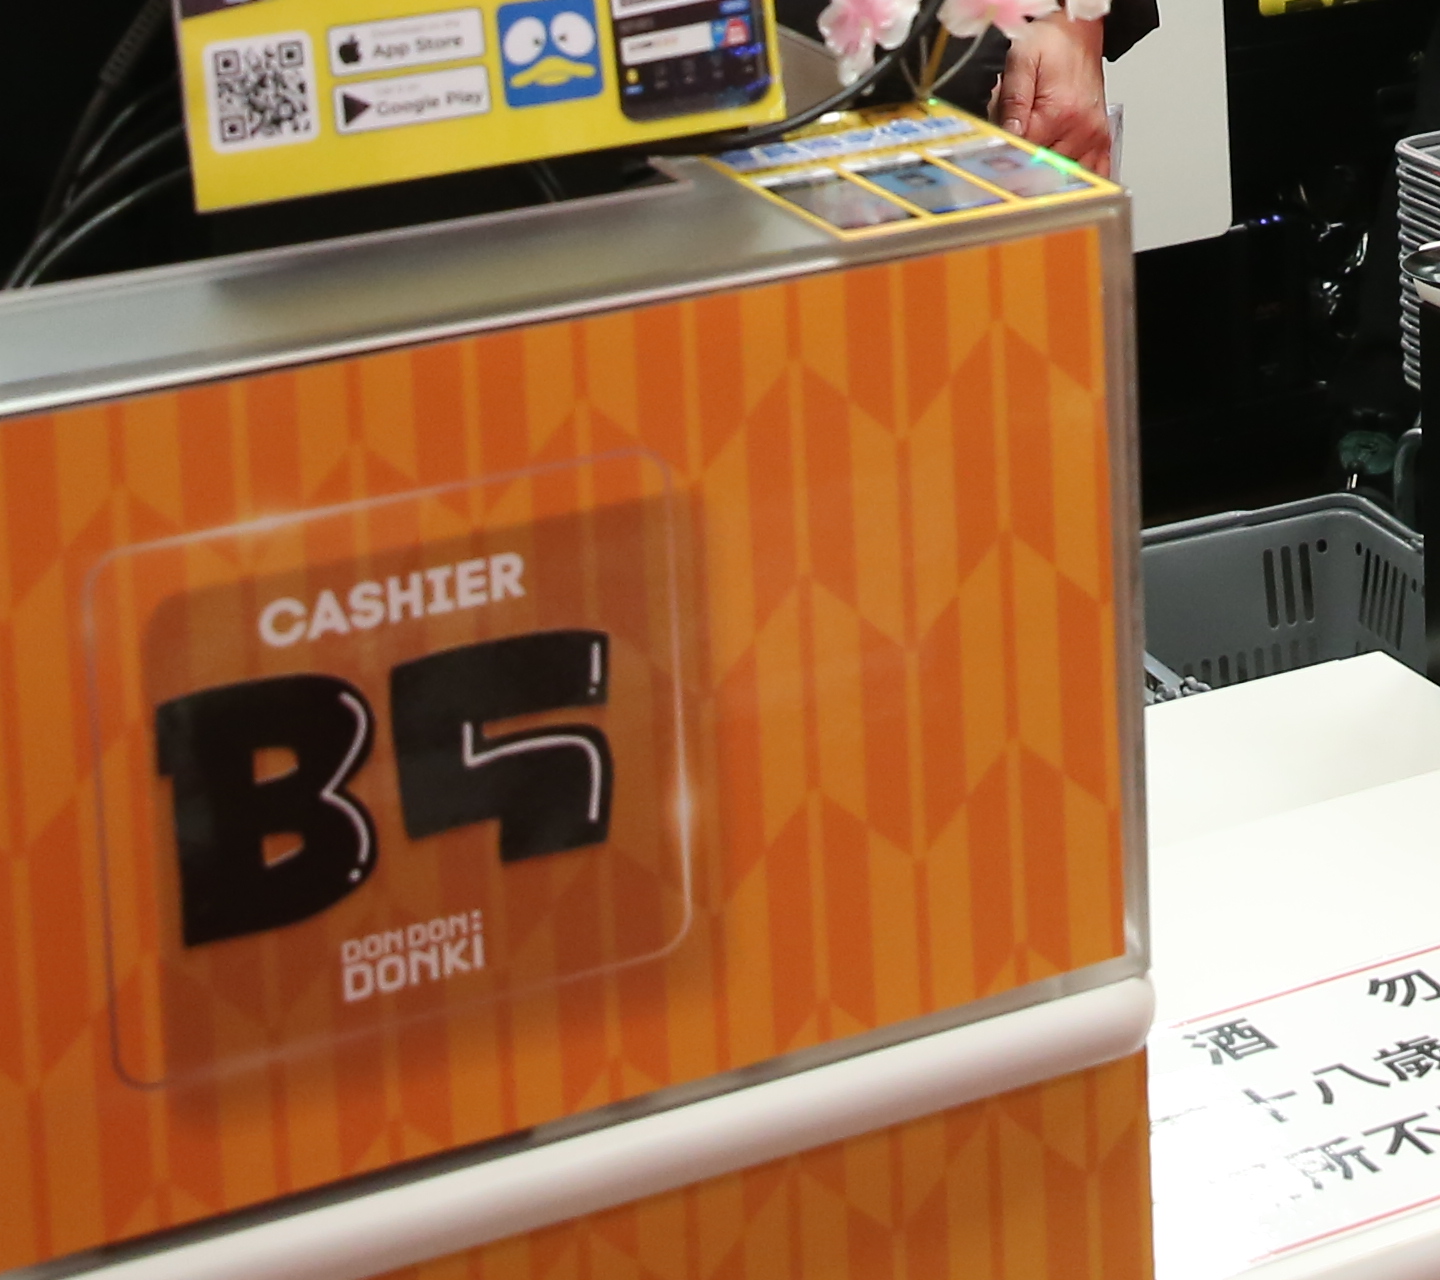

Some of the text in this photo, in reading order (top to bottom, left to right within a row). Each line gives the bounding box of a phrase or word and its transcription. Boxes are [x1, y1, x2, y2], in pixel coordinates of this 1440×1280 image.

[376, 96, 440, 118] Google
[258, 551, 527, 649] CASHIER
[154, 627, 614, 949] B5
[343, 933, 486, 1004] DONKI
